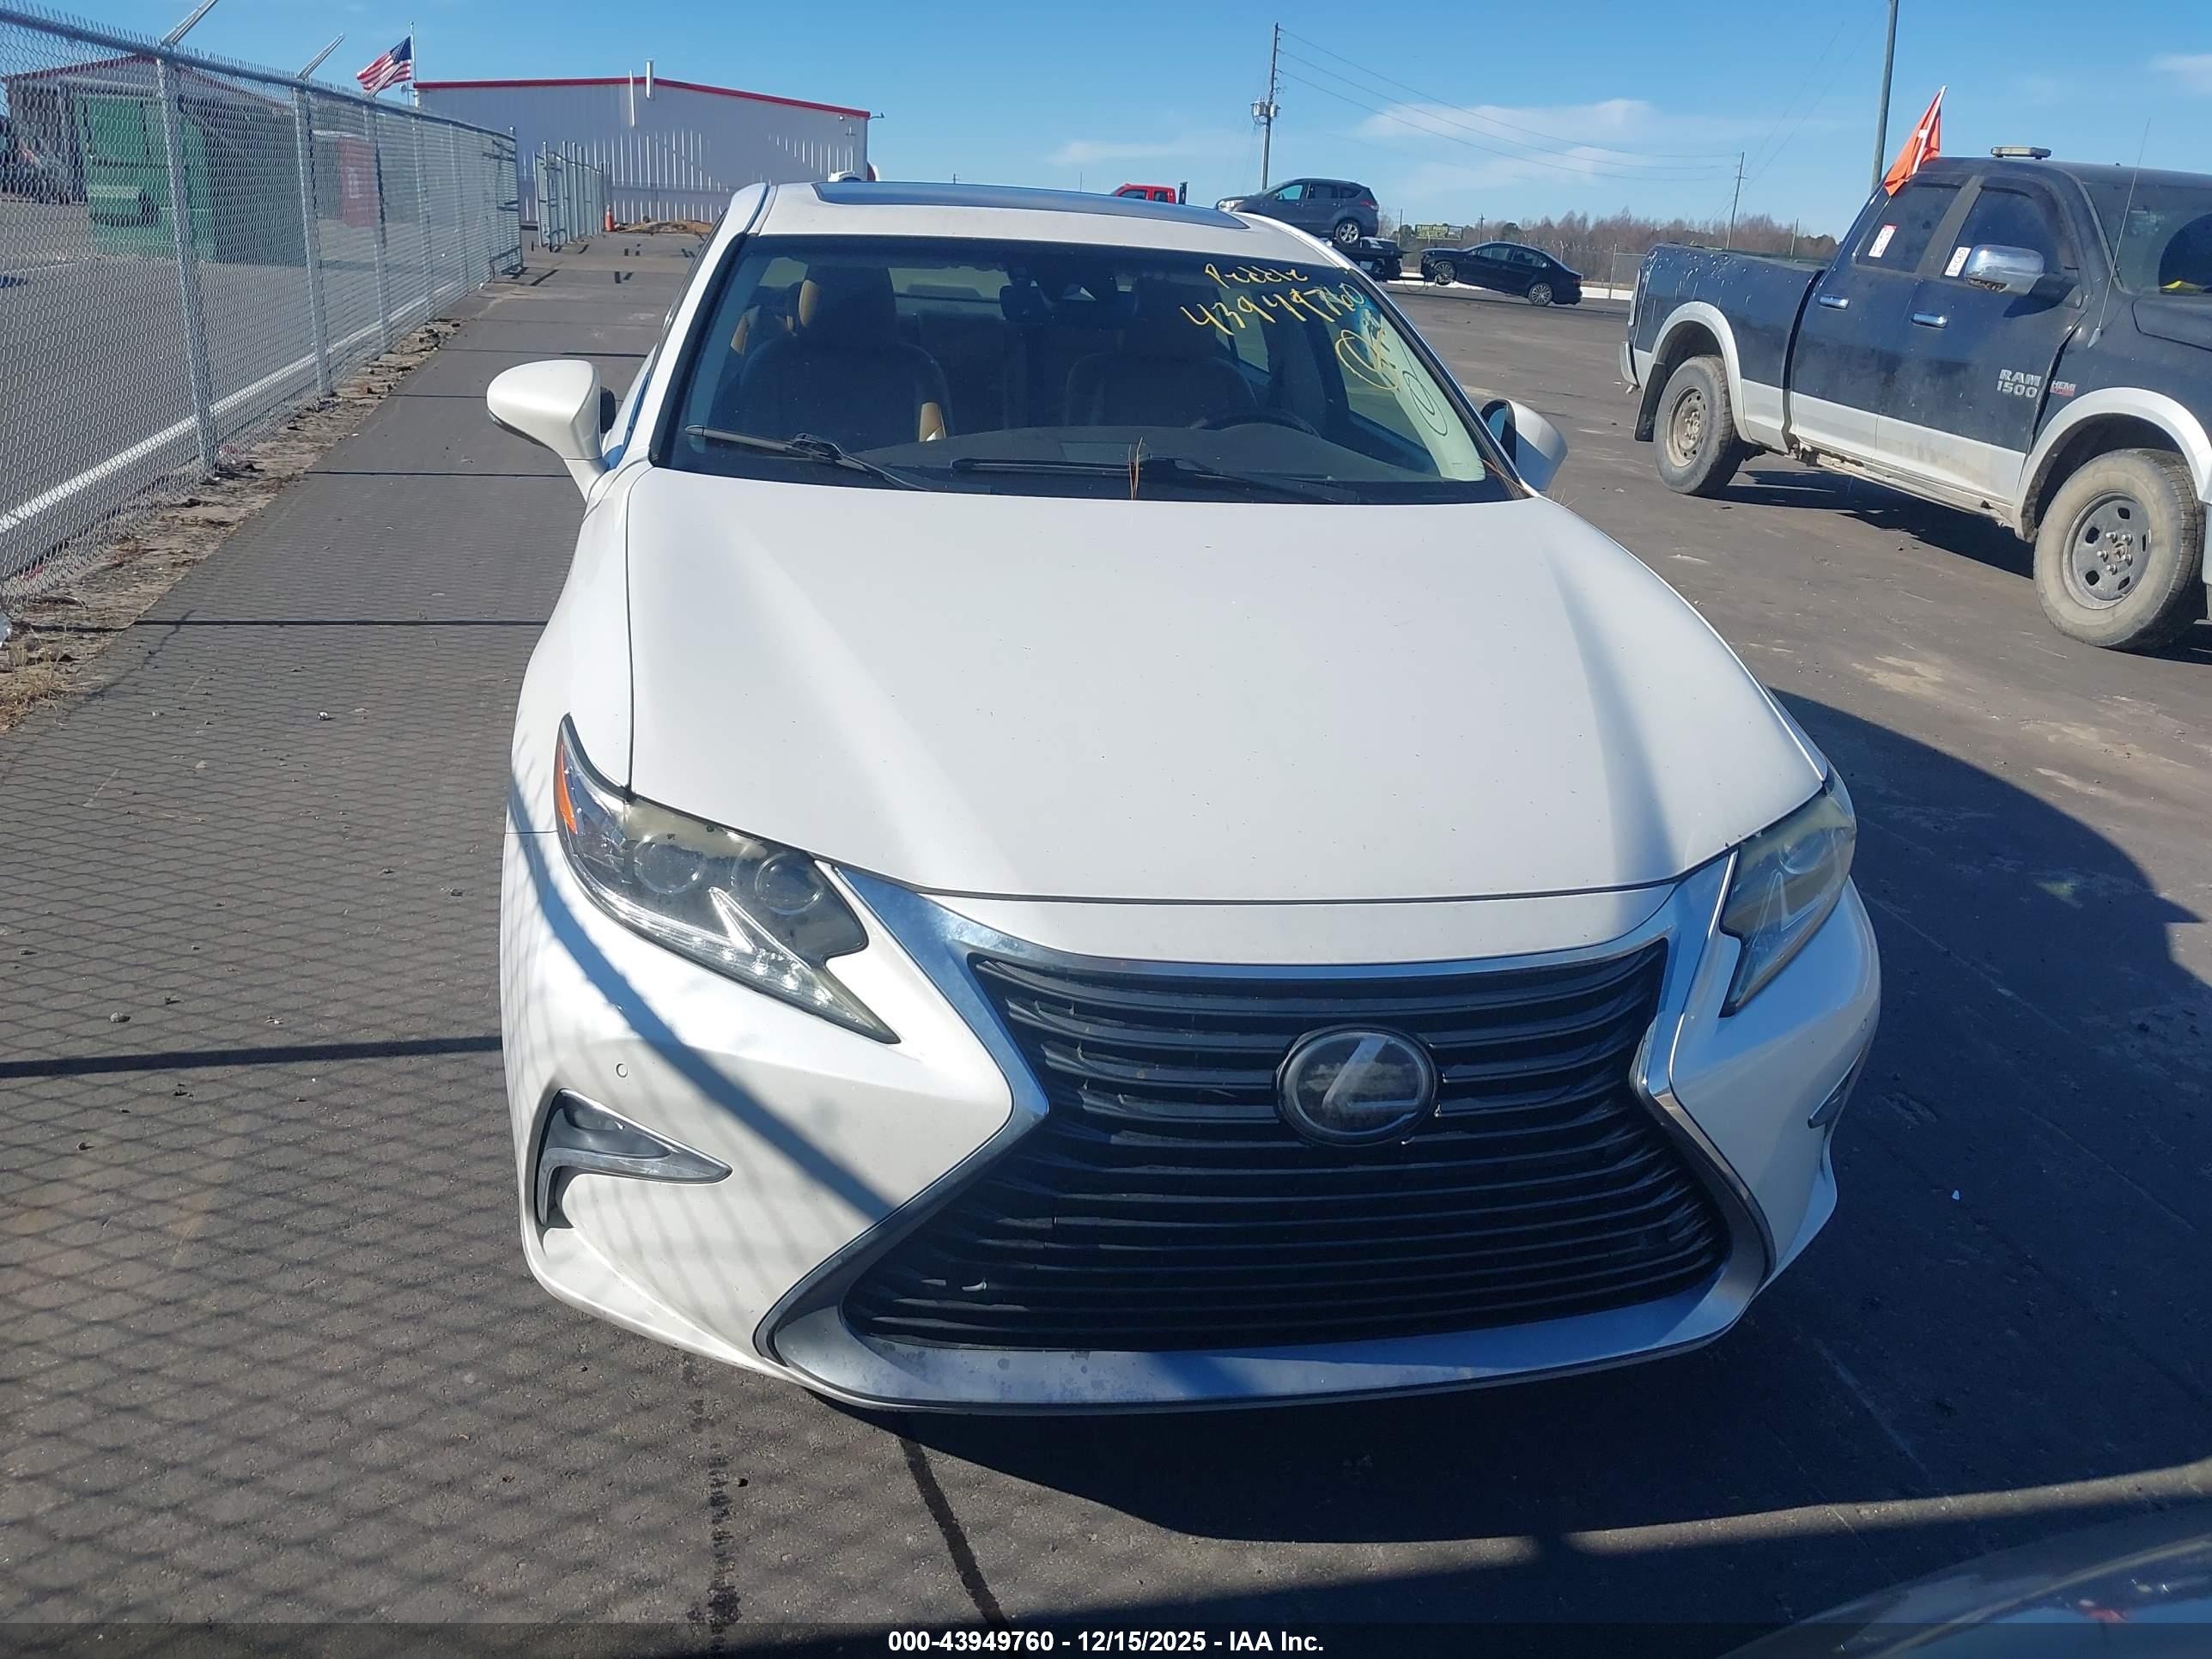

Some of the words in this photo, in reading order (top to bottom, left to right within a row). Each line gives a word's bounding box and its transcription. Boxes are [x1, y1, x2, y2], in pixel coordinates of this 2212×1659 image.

[1999, 368, 2042, 387] RAM
[2051, 380, 2076, 392] HEMI
[1996, 380, 2038, 398] 1500
